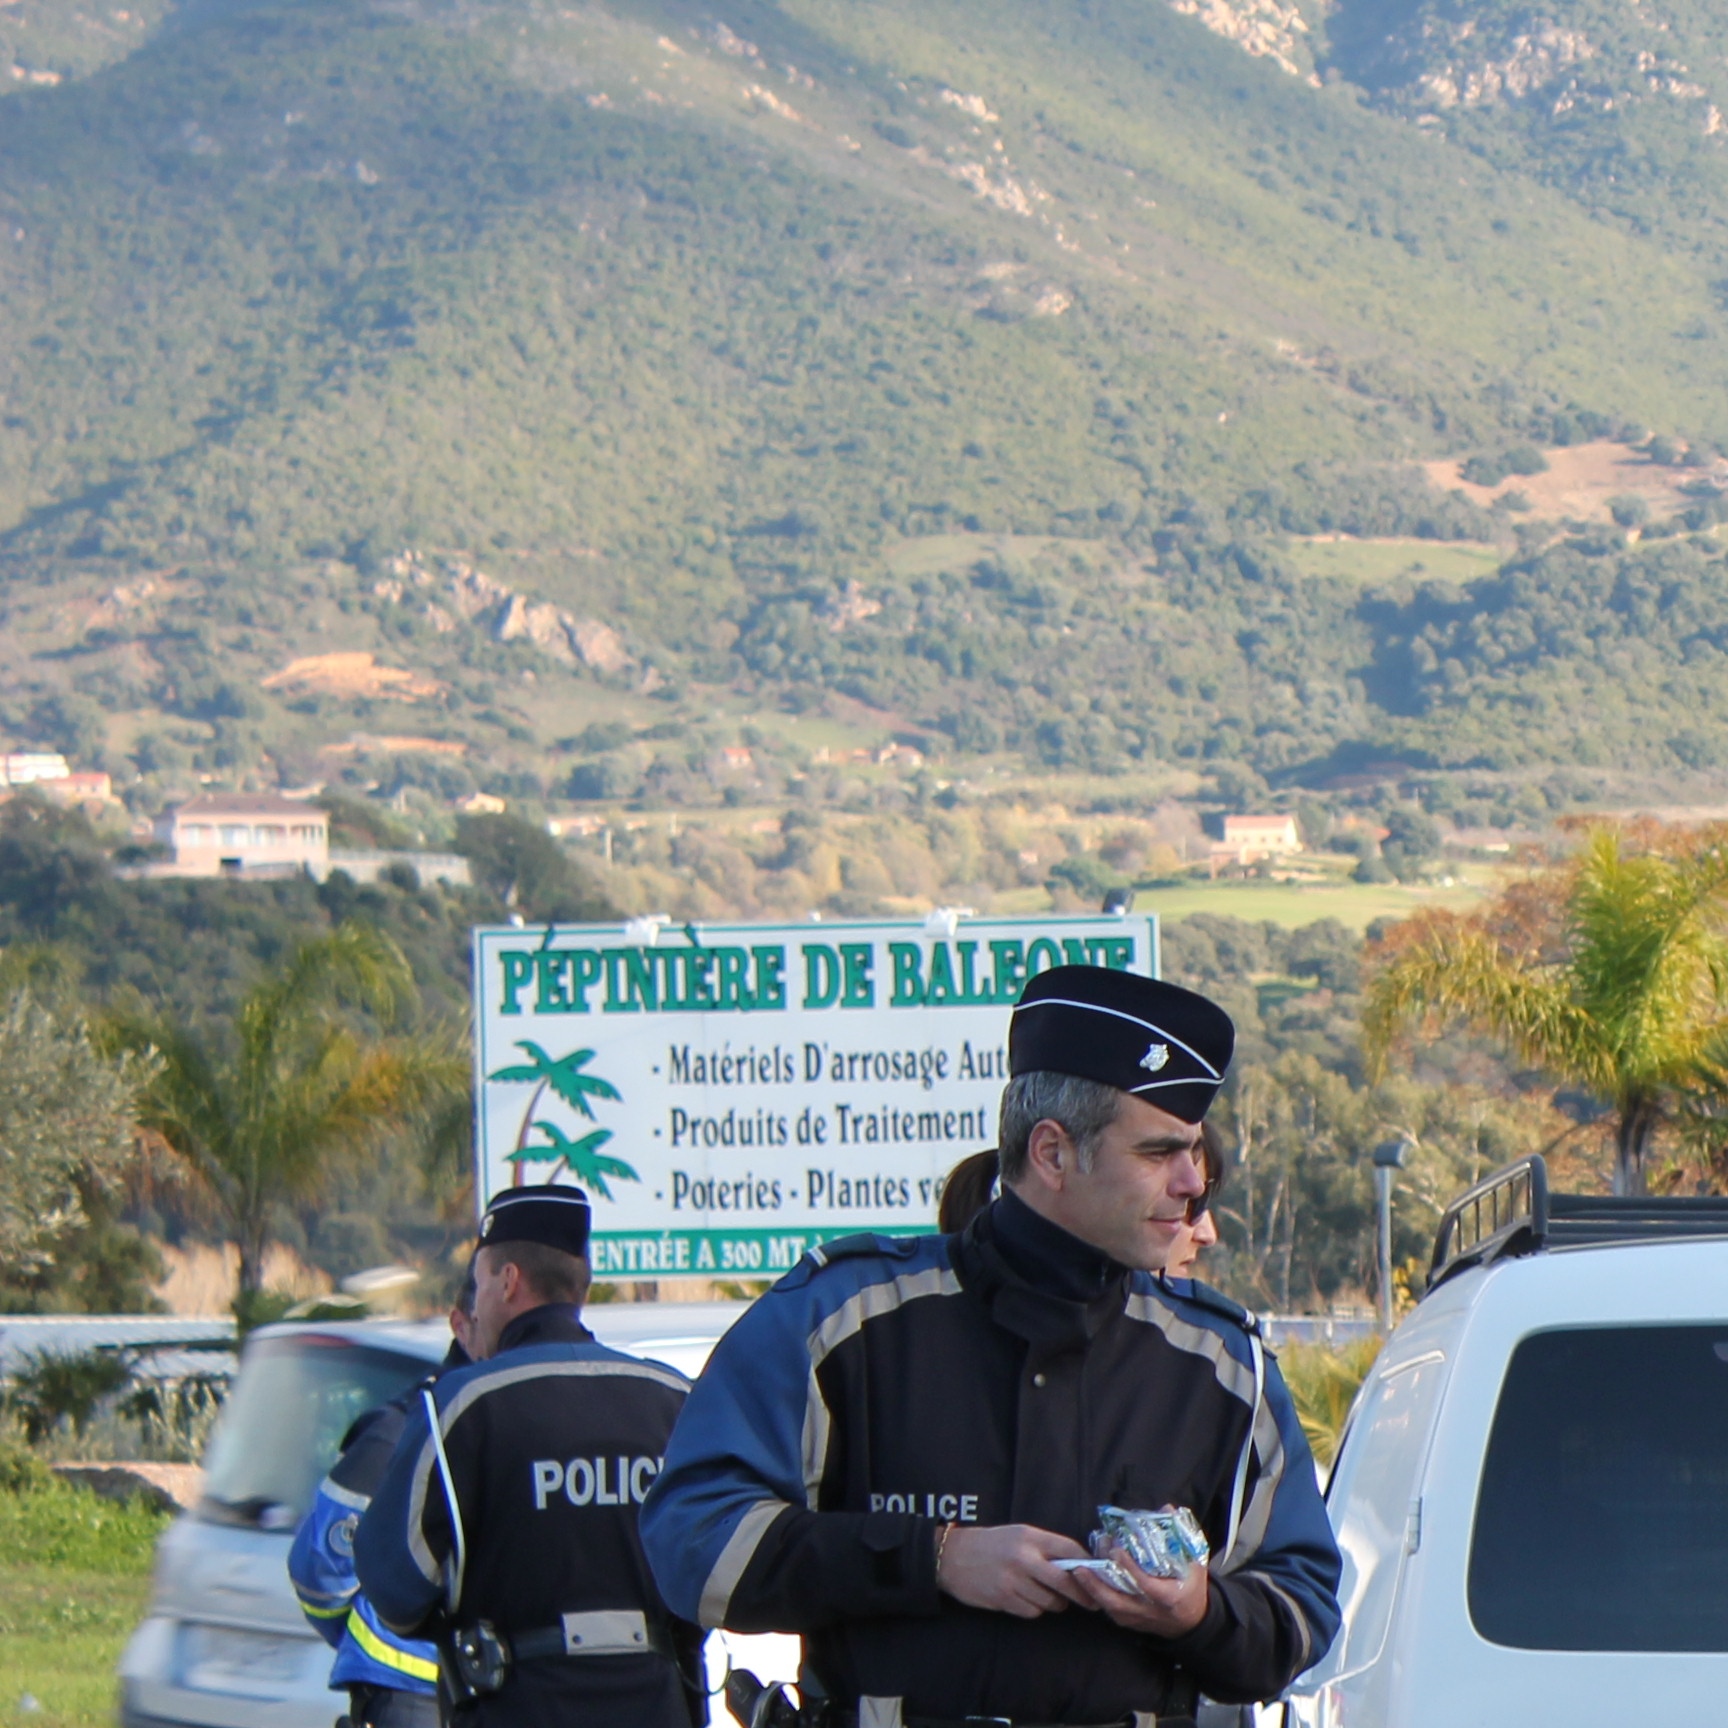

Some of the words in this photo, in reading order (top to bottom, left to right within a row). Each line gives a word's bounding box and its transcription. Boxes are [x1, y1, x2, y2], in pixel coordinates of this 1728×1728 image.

[499, 921, 787, 1015] PÉPINIÈRE
[801, 942, 875, 1009] DE
[669, 1041, 795, 1085] Matériels
[804, 1042, 949, 1091] D'arrosage
[958, 1040, 1010, 1080] Aut
[671, 1107, 788, 1147] Produits
[796, 1106, 827, 1145] de
[836, 1103, 988, 1144] Traitement
[672, 1170, 782, 1211] Poteries
[808, 1168, 910, 1209] Plantes
[591, 1229, 690, 1271] ENTRÉE
[696, 1239, 716, 1270] A
[721, 1241, 763, 1270] 300
[533, 1456, 665, 1510] POLIC
[869, 1493, 979, 1521] POLICE
